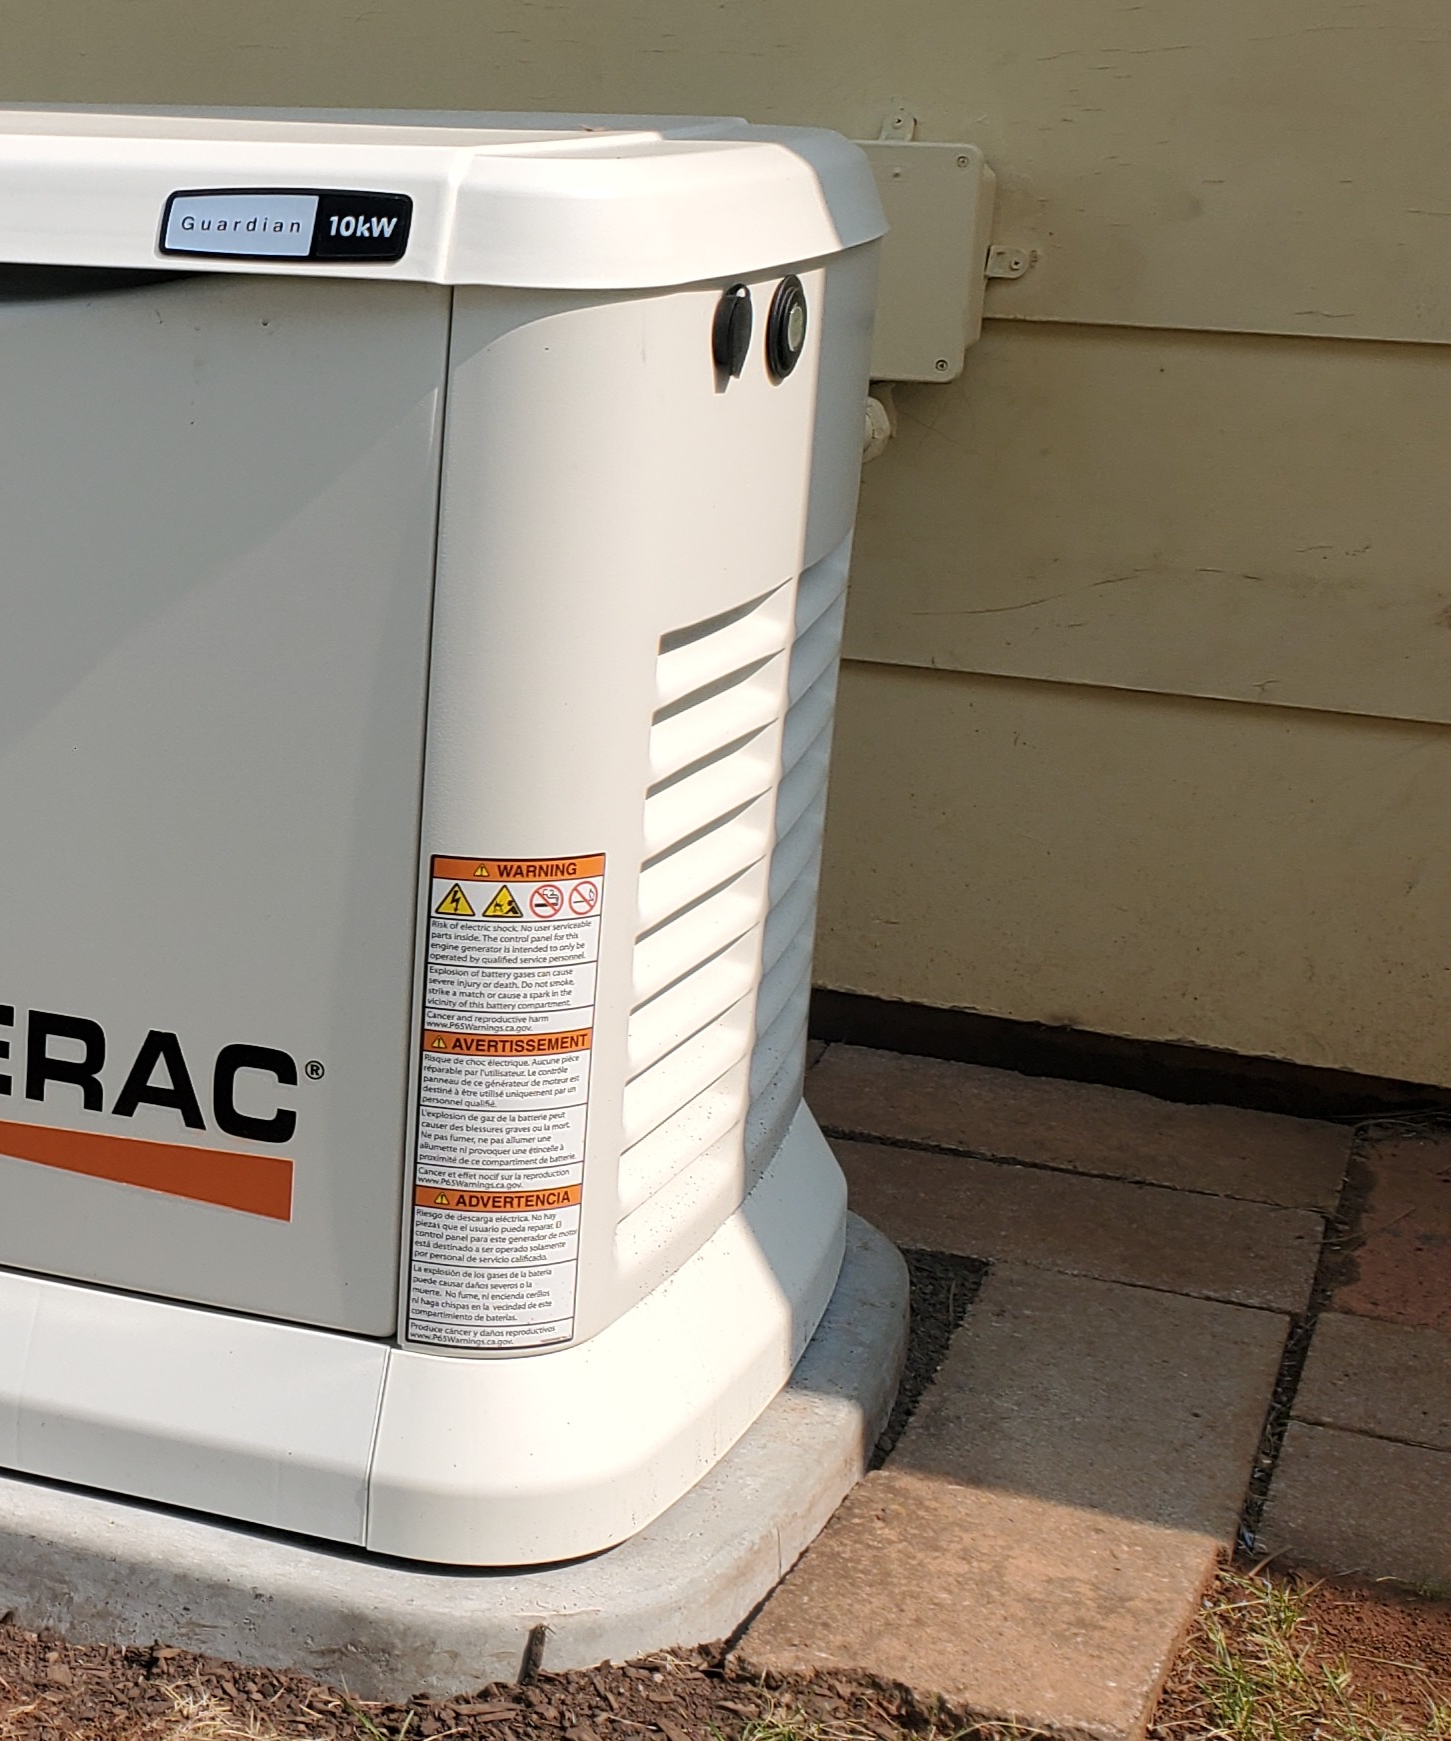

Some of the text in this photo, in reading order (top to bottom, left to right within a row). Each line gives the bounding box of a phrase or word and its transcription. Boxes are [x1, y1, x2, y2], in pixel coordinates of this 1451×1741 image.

[181, 215, 398, 237] Guardian 10kW
[497, 863, 578, 878] WARNING
[431, 919, 448, 929] Risk
[450, 921, 459, 930] of
[460, 922, 491, 932] electric
[520, 924, 533, 932] No
[431, 930, 579, 944] parts inside. The control panel for this
[430, 940, 586, 955] engine generator is intended to only be
[429, 950, 586, 965] operated by qualified service personnel.
[429, 965, 469, 979] Explosion
[470, 969, 479, 978] of
[481, 970, 512, 980] battery
[513, 971, 536, 980] gases
[552, 968, 573, 976] cause
[429, 978, 455, 986] severe
[456, 978, 481, 990] injury
[494, 980, 520, 989] death.
[521, 980, 533, 988] Do
[534, 980, 548, 988] not
[428, 986, 450, 996] strike
[459, 989, 485, 998] match
[529, 989, 551, 1000] spark
[560, 987, 572, 996] the
[427, 996, 457, 1009] vicinity
[458, 999, 467, 1008] of
[469, 1000, 484, 1009] this
[486, 1001, 516, 1011] battery
[427, 1010, 454, 1021] Cancer
[456, 1013, 473, 1022] and
[529, 1013, 549, 1022] harm
[452, 1033, 588, 1053] AVERTISSEMENT
[456, 1190, 570, 1208] ADVERTENCIA
